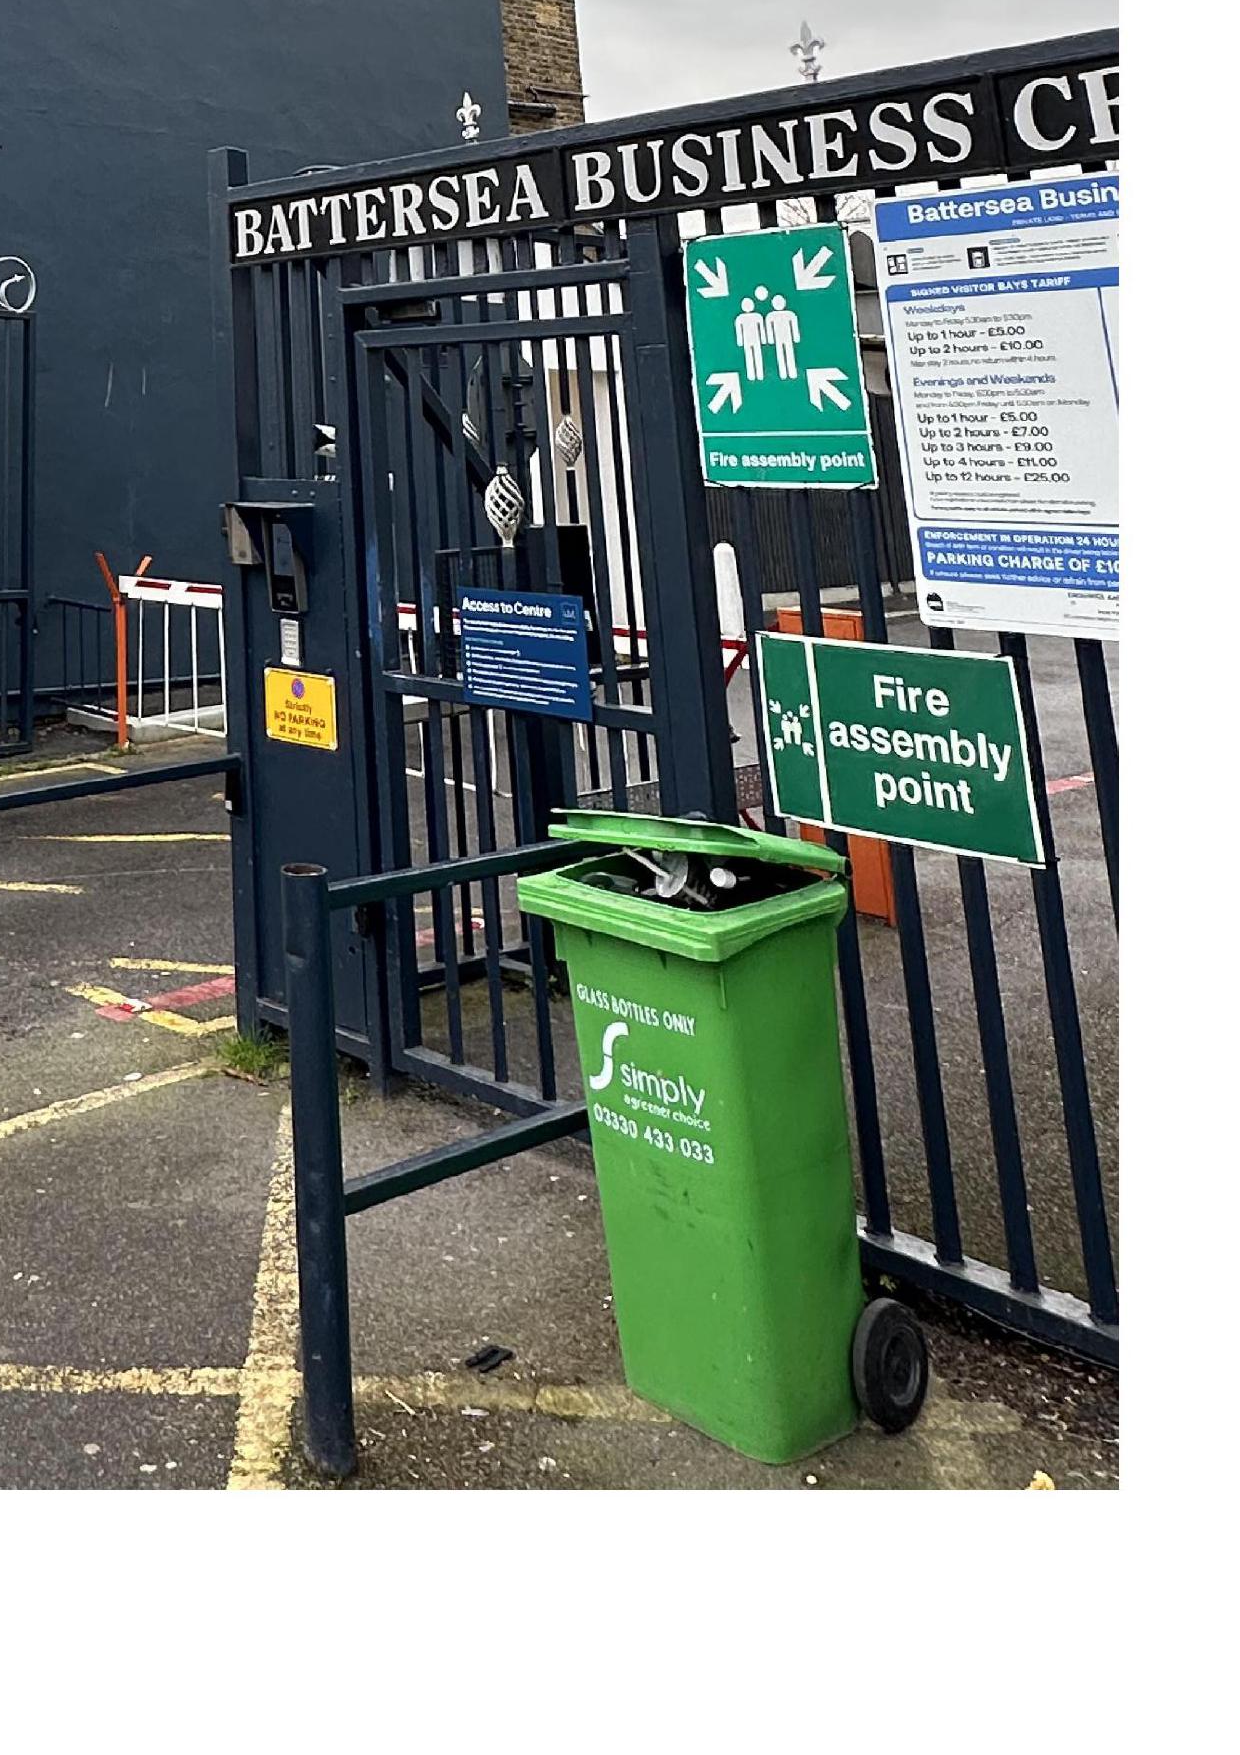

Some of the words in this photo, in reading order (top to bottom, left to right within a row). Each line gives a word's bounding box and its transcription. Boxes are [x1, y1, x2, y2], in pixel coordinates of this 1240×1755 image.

[234, 162, 550, 260] BATTERSEA
[572, 92, 975, 213] BUSINESS
[907, 195, 1034, 224] Battersea
[951, 284, 995, 294] VISITOR
[998, 280, 1028, 291] BAYS
[1030, 277, 1071, 288] TARIFF
[903, 304, 965, 315] Weekdays
[908, 332, 924, 342] Up
[927, 331, 938, 340] to
[941, 330, 946, 339] 1
[949, 329, 977, 339] hour
[988, 325, 1025, 337] £5.00
[910, 346, 926, 357] Up
[929, 345, 940, 354] to
[943, 344, 951, 354] 2
[953, 343, 989, 353] hours
[1000, 339, 1043, 351] £10.00
[913, 377, 964, 388] Evenings
[966, 375, 988, 386] and
[990, 373, 1056, 385] Weekends
[917, 413, 934, 425] Up
[936, 413, 949, 423] to
[951, 413, 957, 422] 1
[960, 411, 988, 422] hour
[1000, 411, 1038, 422] £5.00
[919, 428, 936, 439] Up
[939, 427, 951, 437] to
[953, 427, 963, 438] 2
[964, 427, 1000, 437] hours
[1011, 426, 1049, 438] £7.00
[921, 442, 938, 453] Up
[941, 442, 954, 452] to
[956, 442, 965, 452] 3
[967, 442, 1003, 452] hours
[710, 452, 738, 467] Fire
[742, 452, 816, 471] assembly
[820, 452, 865, 471] point
[923, 457, 940, 468] Up
[943, 457, 955, 467] to
[958, 457, 967, 466] 4
[969, 457, 1005, 467] hours
[1017, 457, 1057, 467] £11.00
[926, 471, 942, 482] Up
[945, 471, 958, 482] to
[961, 471, 972, 481] 12
[975, 471, 1011, 482] hours
[1024, 472, 1070, 483] £25.00
[924, 530, 997, 543] ENFORCEMENT
[999, 534, 1011, 543] IN
[1013, 534, 1074, 545] OPERATION
[1077, 536, 1091, 546] 24
[1093, 536, 1119, 547] HOU
[927, 552, 994, 567] PARKING
[998, 555, 1066, 572] CHARGE
[1068, 558, 1091, 573] OF
[462, 596, 500, 613] Access
[500, 602, 513, 614] to
[514, 601, 552, 618] Centre
[873, 674, 950, 717] Fire
[274, 710, 287, 722] NO
[288, 712, 326, 729] PARKING
[288, 727, 302, 738] any
[828, 720, 1011, 782] assembly
[874, 771, 975, 815] point
[576, 983, 610, 1011] GLASS
[611, 995, 660, 1026] BOTTLES
[663, 1011, 696, 1037] ONLY
[620, 1062, 706, 1115] simply
[672, 1110, 711, 1132] choice
[593, 1103, 638, 1139] 03330
[643, 1125, 674, 1153] 433
[680, 1138, 715, 1165] 033
